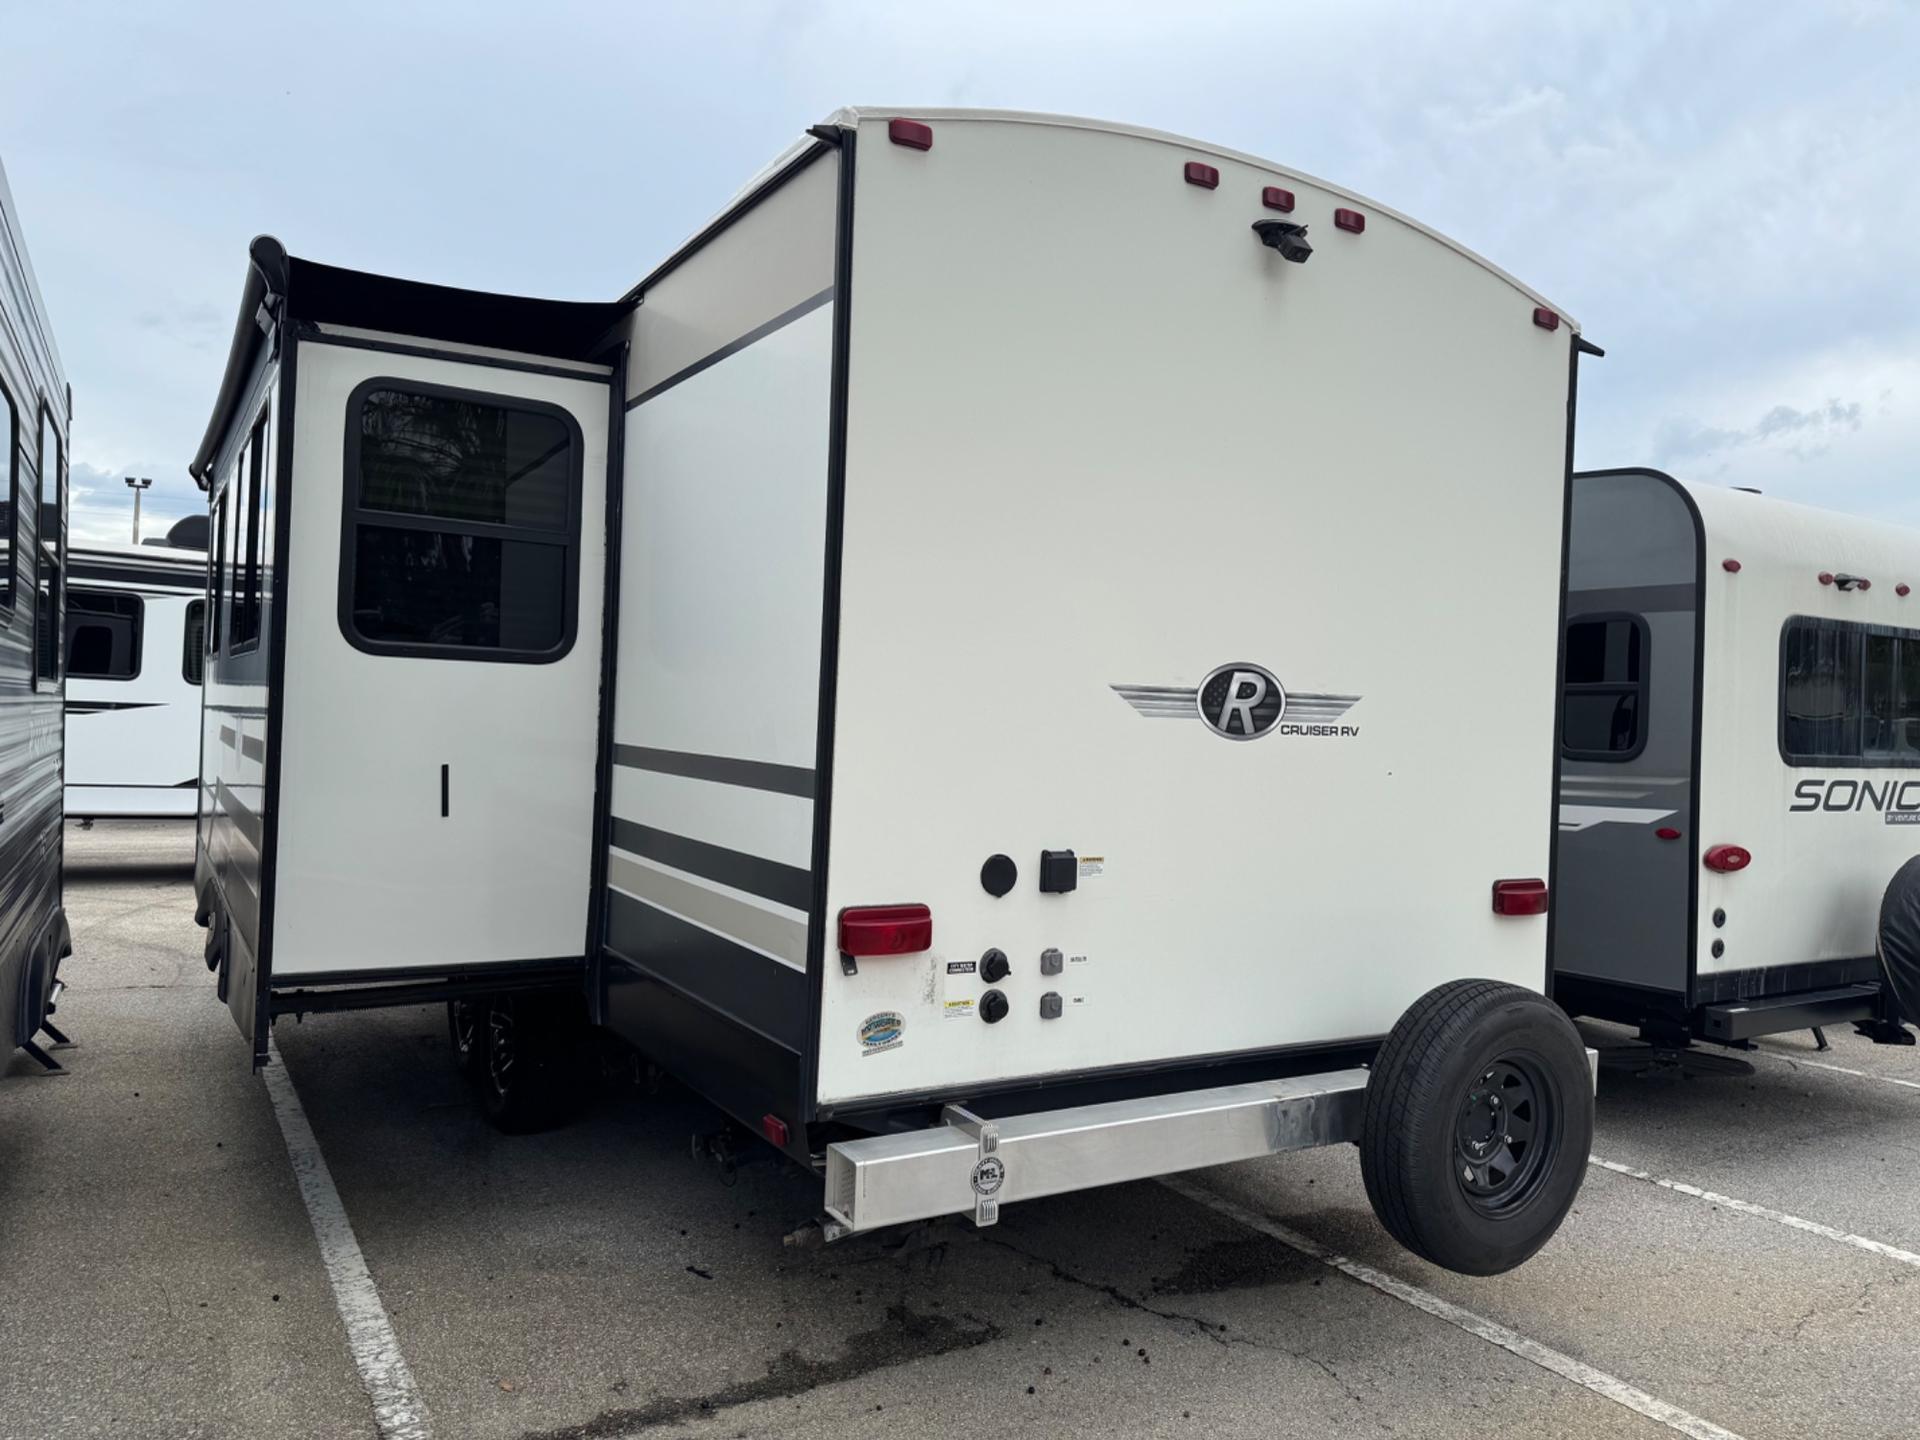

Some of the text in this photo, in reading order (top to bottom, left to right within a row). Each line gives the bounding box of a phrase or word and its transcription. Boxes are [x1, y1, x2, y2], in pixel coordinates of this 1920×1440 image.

[1218, 671, 1267, 734] R
[1280, 724, 1360, 737] CRUISER RV
[1788, 779, 1920, 812] SONIC
